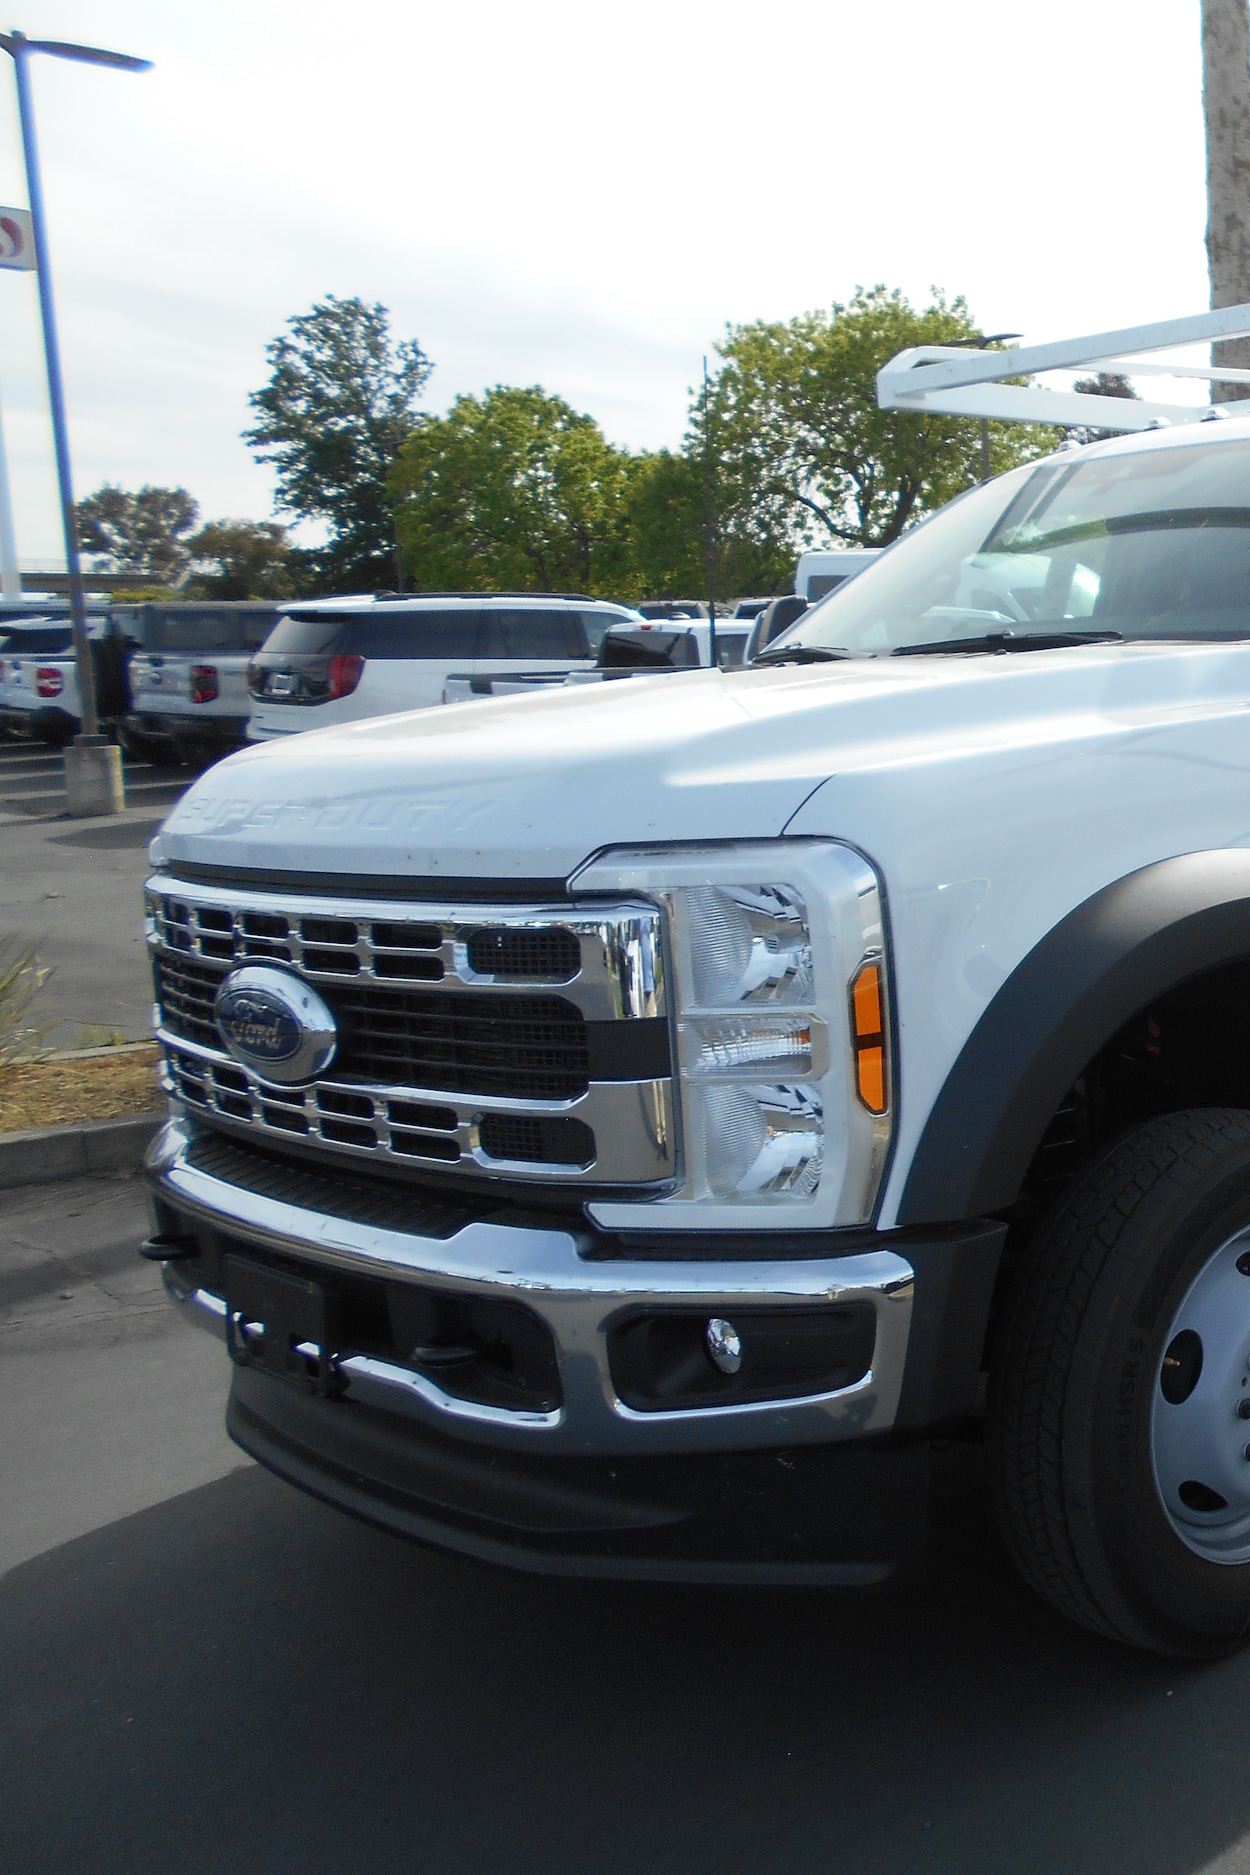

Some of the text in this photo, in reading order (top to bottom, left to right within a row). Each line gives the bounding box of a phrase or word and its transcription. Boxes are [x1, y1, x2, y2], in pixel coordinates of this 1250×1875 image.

[178, 797, 497, 832] SUPER DUTY
[230, 998, 283, 1049] Ford
